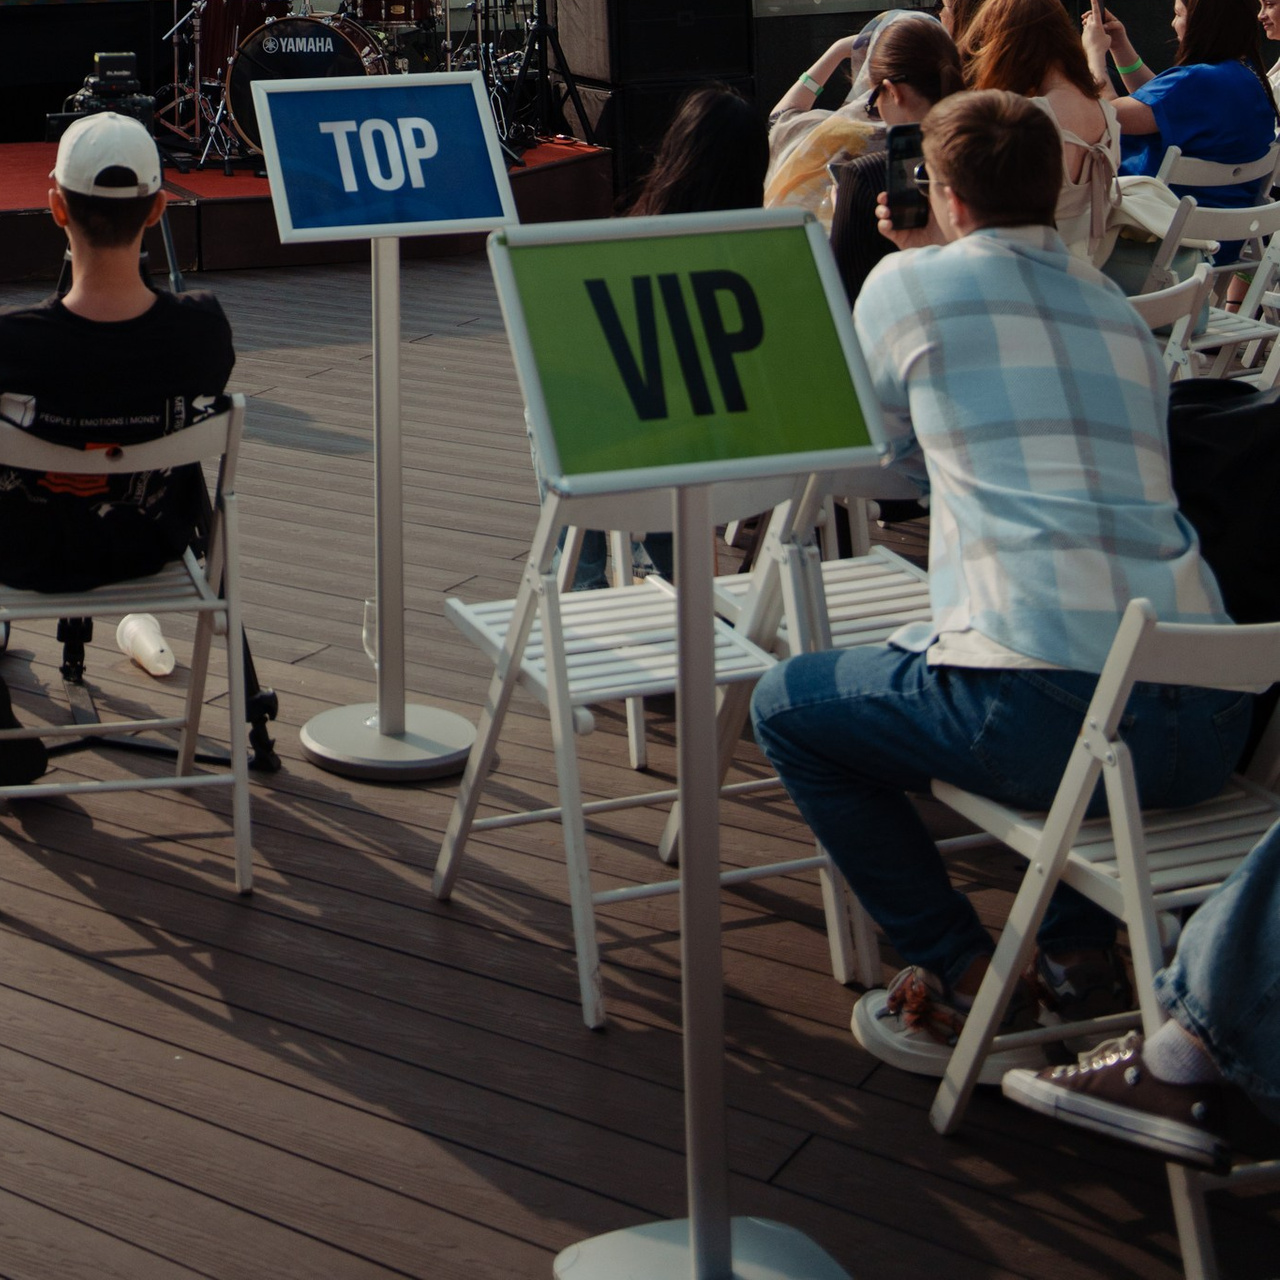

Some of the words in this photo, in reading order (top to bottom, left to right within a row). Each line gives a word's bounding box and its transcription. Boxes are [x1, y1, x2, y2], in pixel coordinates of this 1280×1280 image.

[279, 36, 334, 53] YAMAHA
[319, 116, 439, 193] TOP
[583, 268, 766, 423] VIP
[39, 411, 72, 426] PEOPLE
[79, 416, 124, 427] EMOTIONS
[129, 414, 161, 425] MONEY
